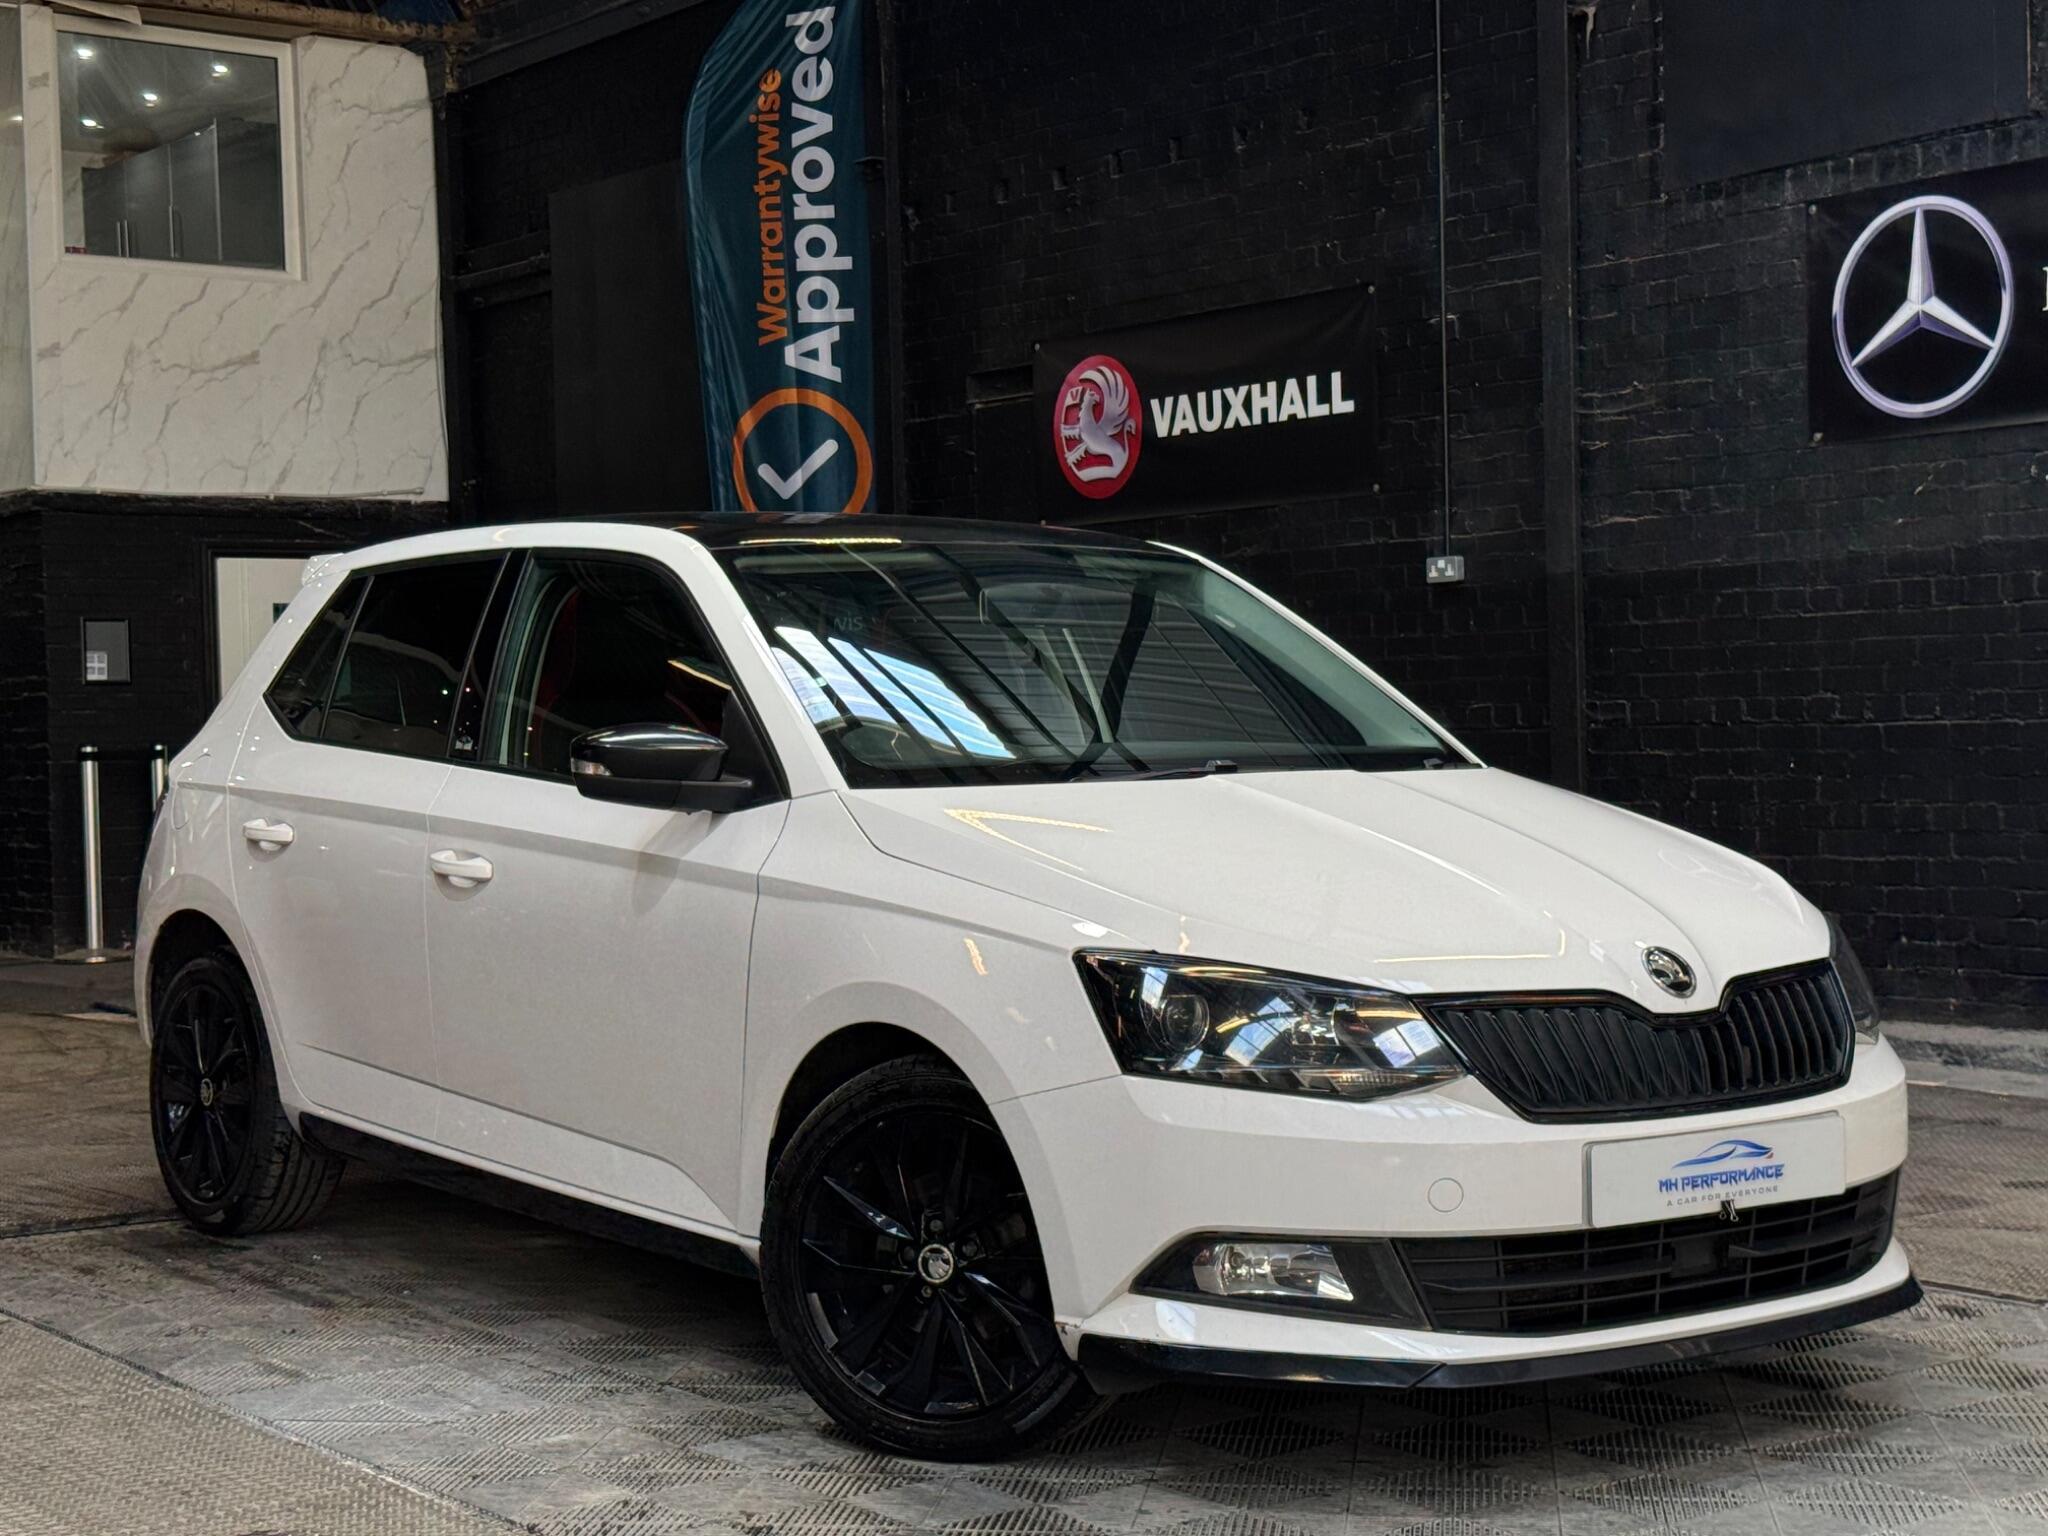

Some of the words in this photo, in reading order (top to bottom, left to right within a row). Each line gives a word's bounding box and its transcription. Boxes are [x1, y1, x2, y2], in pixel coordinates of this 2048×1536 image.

[749, 69, 788, 346] Warrantywise
[785, 6, 855, 383] Approved
[1150, 371, 1355, 438] VAUXHALL
[1658, 1178, 1679, 1193] MH
[1680, 1164, 1785, 1192] PERFORMANCE
[1676, 1197, 1698, 1206] CAR
[1701, 1194, 1721, 1202] FOR
[1725, 1185, 1779, 1199] EVERYONE
